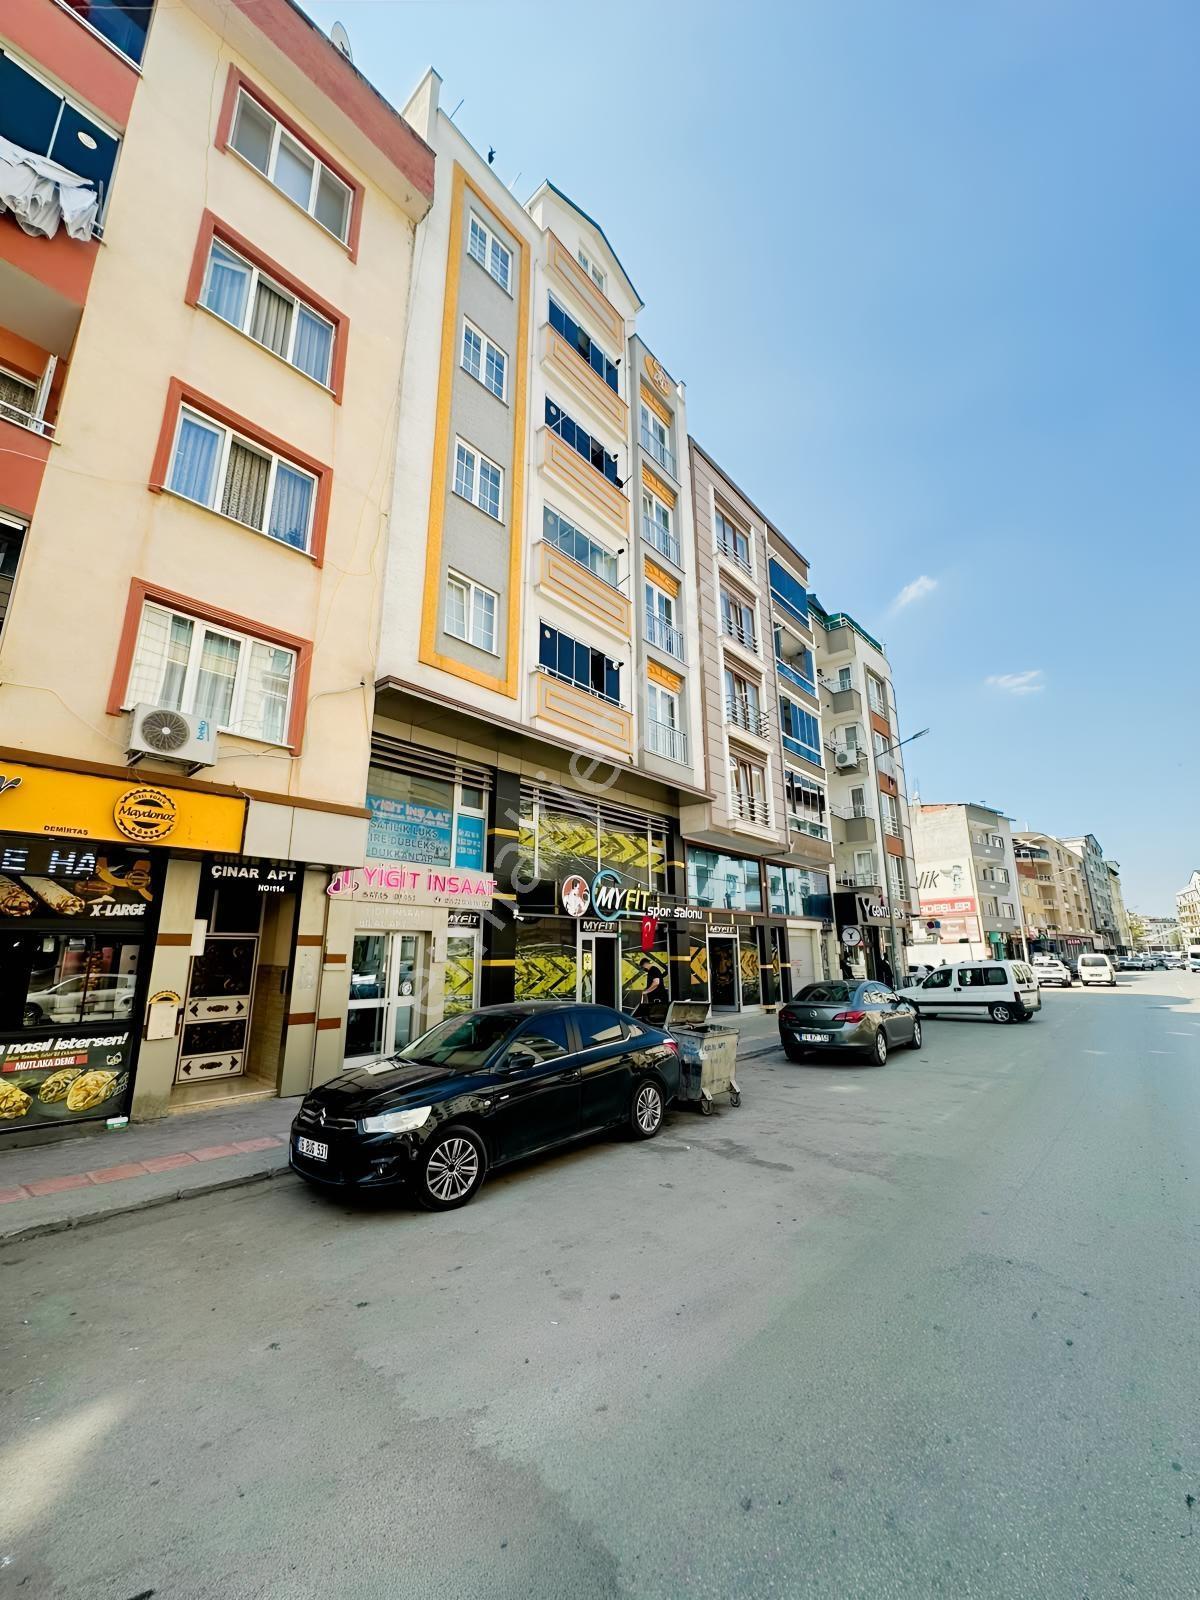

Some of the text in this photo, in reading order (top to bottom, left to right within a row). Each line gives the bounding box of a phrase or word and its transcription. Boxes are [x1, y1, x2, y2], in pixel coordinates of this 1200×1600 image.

[197, 720, 207, 741] beko
[118, 805, 176, 823] Maydonoz
[211, 865, 297, 881] ÇINAR APT
[917, 870, 940, 889] lik
[89, 903, 147, 917] X-LARGE
[647, 906, 703, 919] spor salonu
[7, 1038, 54, 1054] nasıl
[54, 1031, 130, 1050] istersen!
[14, 1060, 54, 1071] MUTLAKA
